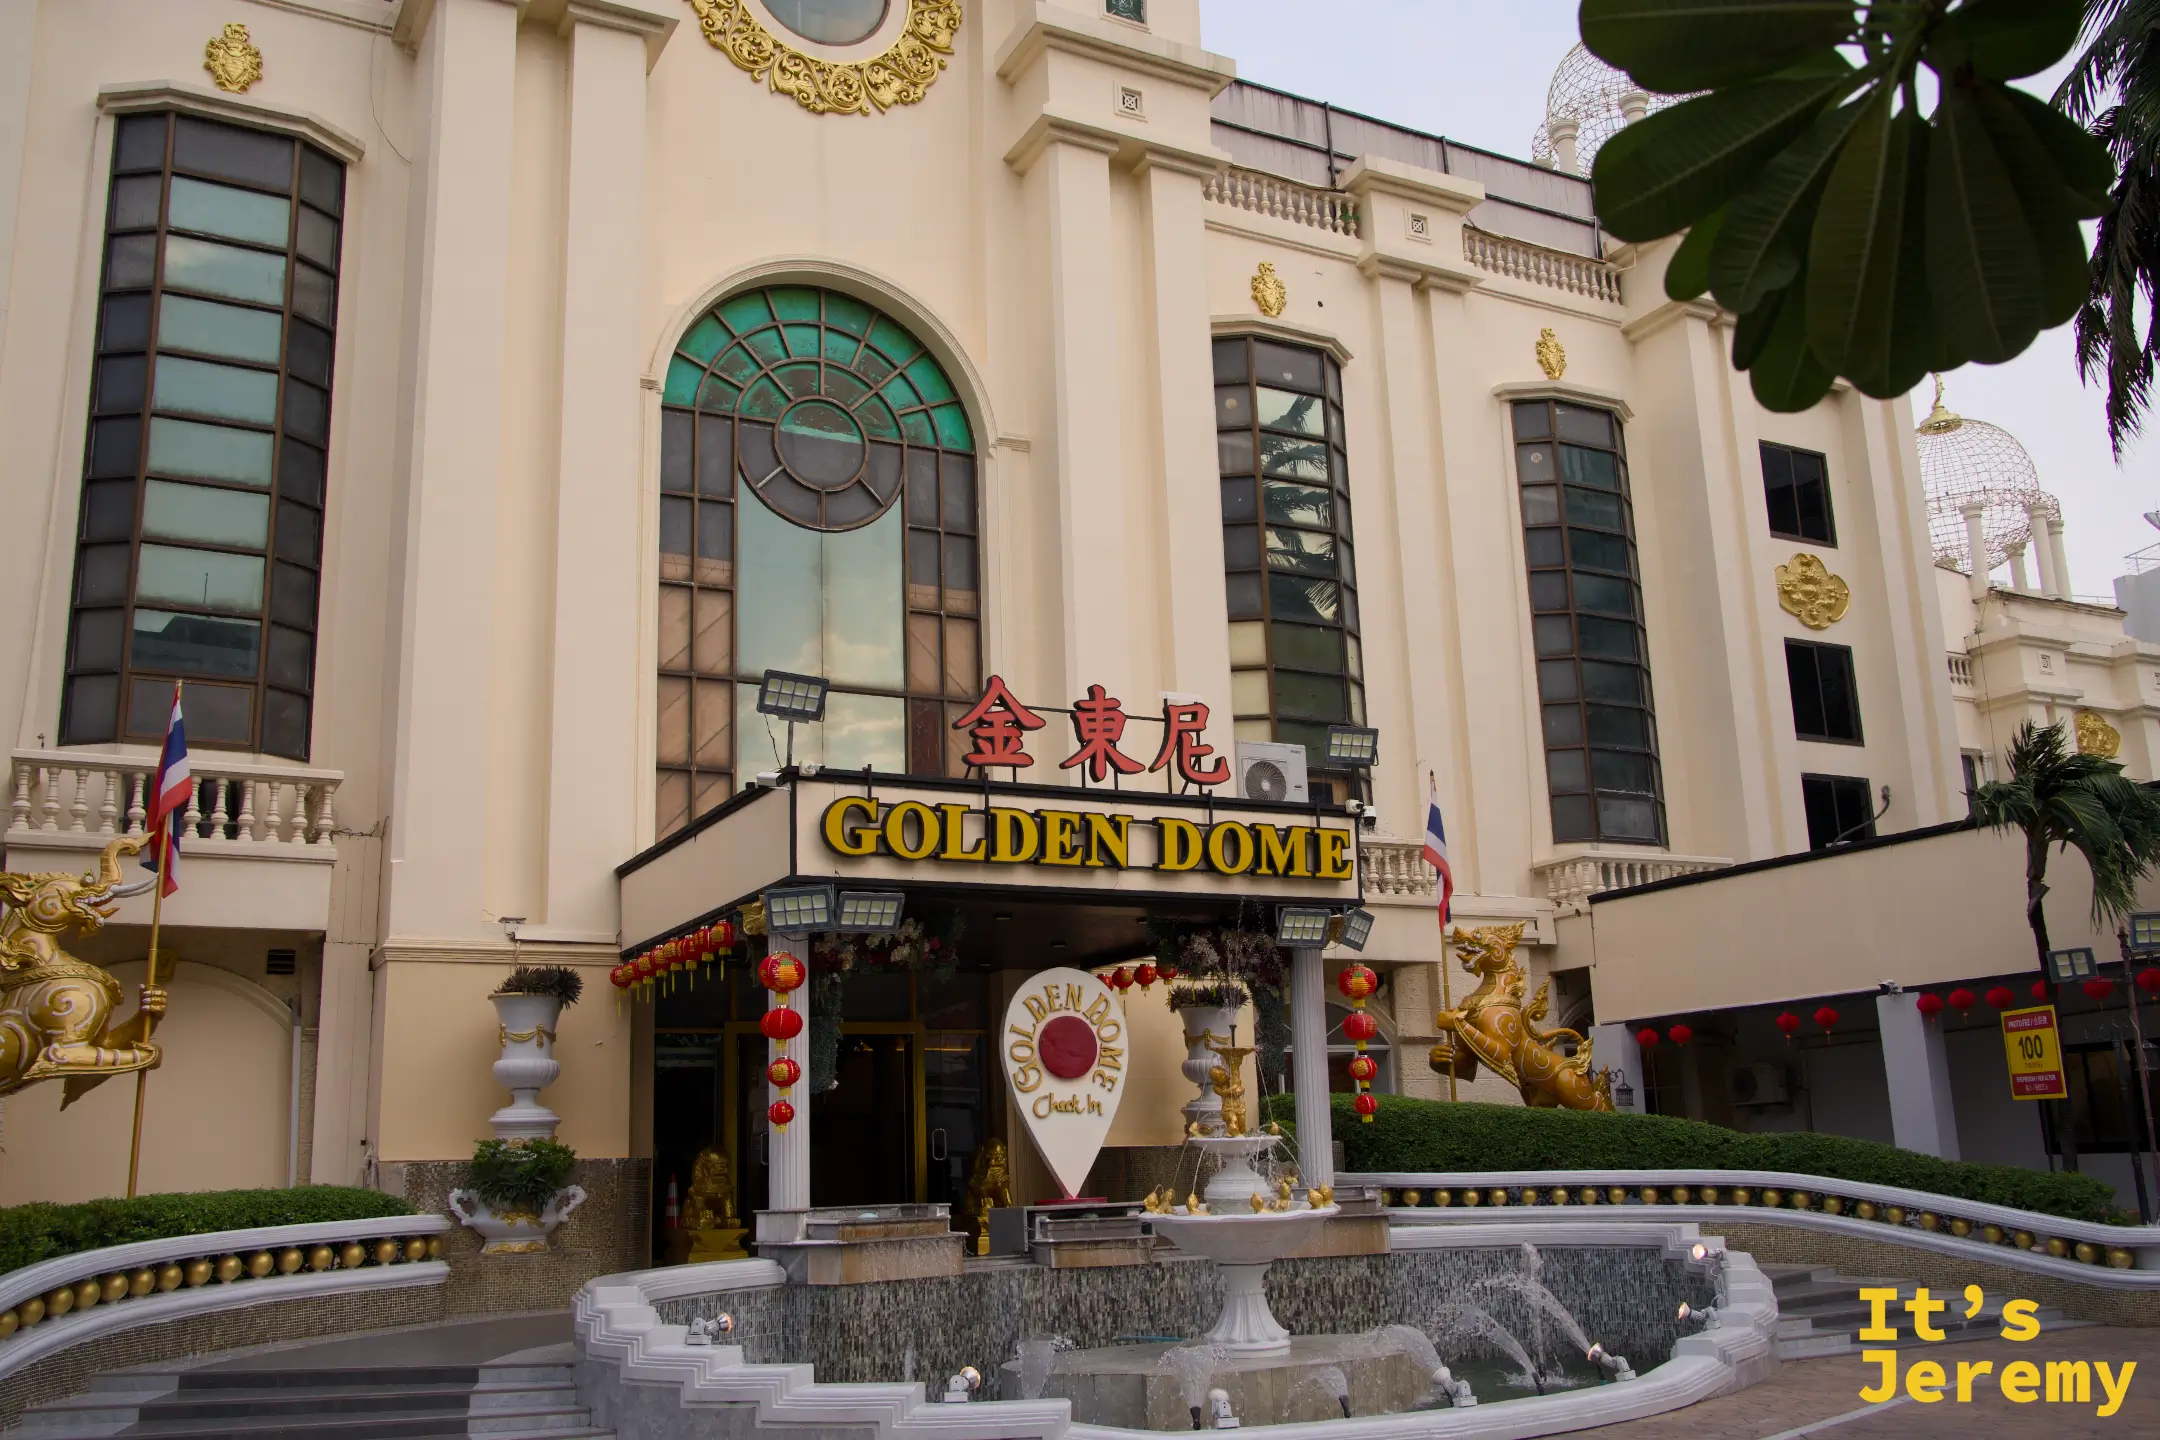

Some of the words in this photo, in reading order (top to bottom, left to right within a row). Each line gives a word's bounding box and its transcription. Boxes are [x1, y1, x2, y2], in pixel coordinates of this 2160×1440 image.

[953, 674, 1231, 785] 金東尼
[820, 796, 1133, 870] GOLDEN
[1152, 815, 1354, 881] DOME
[1009, 983, 1085, 1093] GOLDEN
[1082, 992, 1124, 1092] DOME
[2018, 1034, 2044, 1060] 100
[1032, 1092, 1085, 1119] Check
[1087, 1093, 1104, 1116] In
